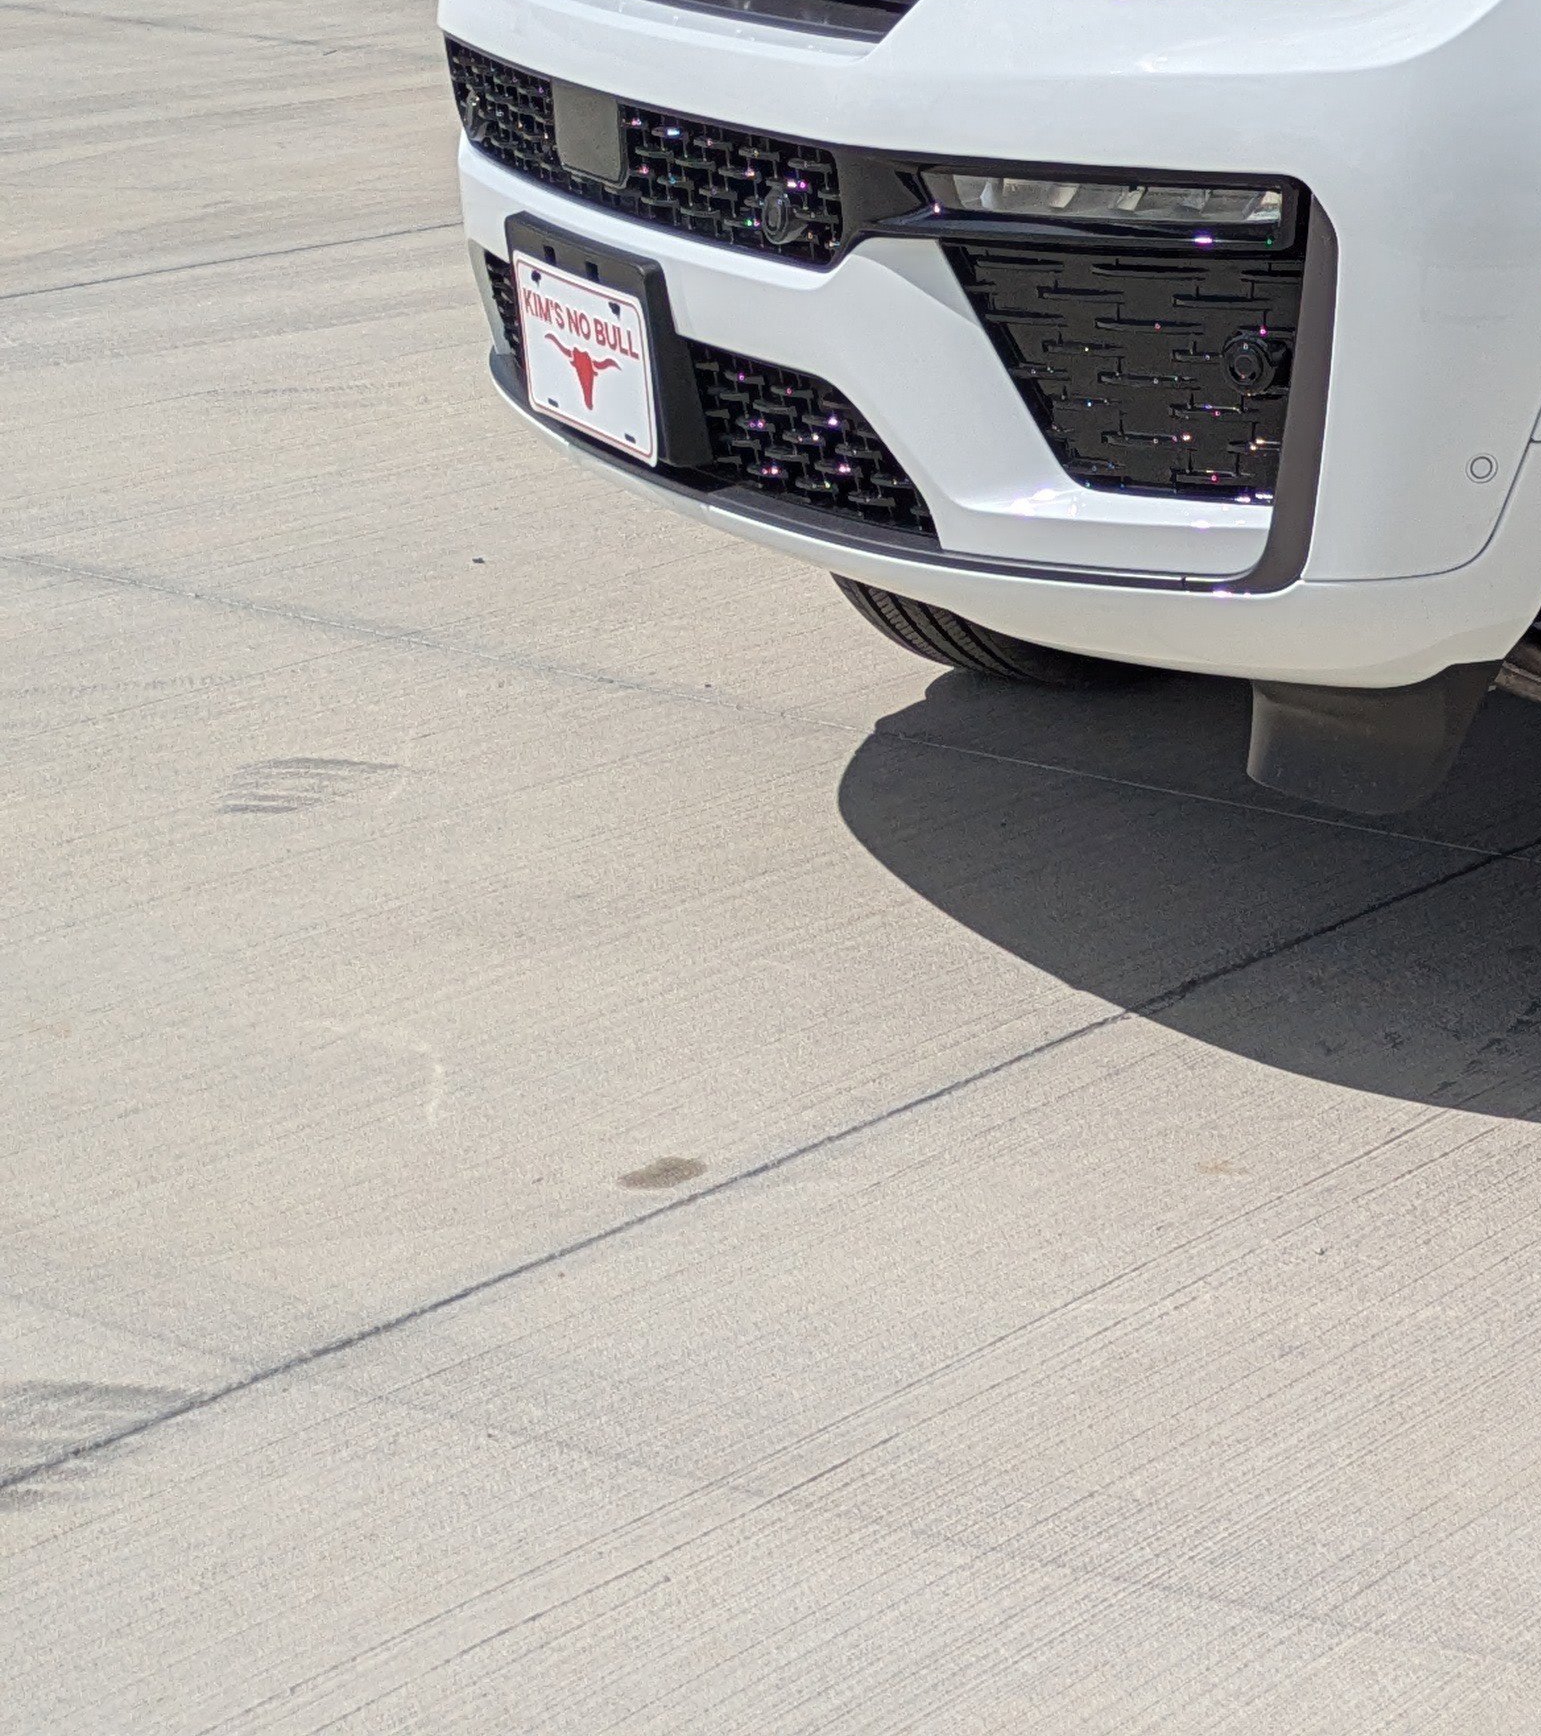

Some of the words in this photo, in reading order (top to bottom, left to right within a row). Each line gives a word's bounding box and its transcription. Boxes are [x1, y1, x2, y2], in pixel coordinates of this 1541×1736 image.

[522, 287, 565, 330] KIM'S
[565, 307, 591, 341] NO
[593, 317, 640, 361] BULL
